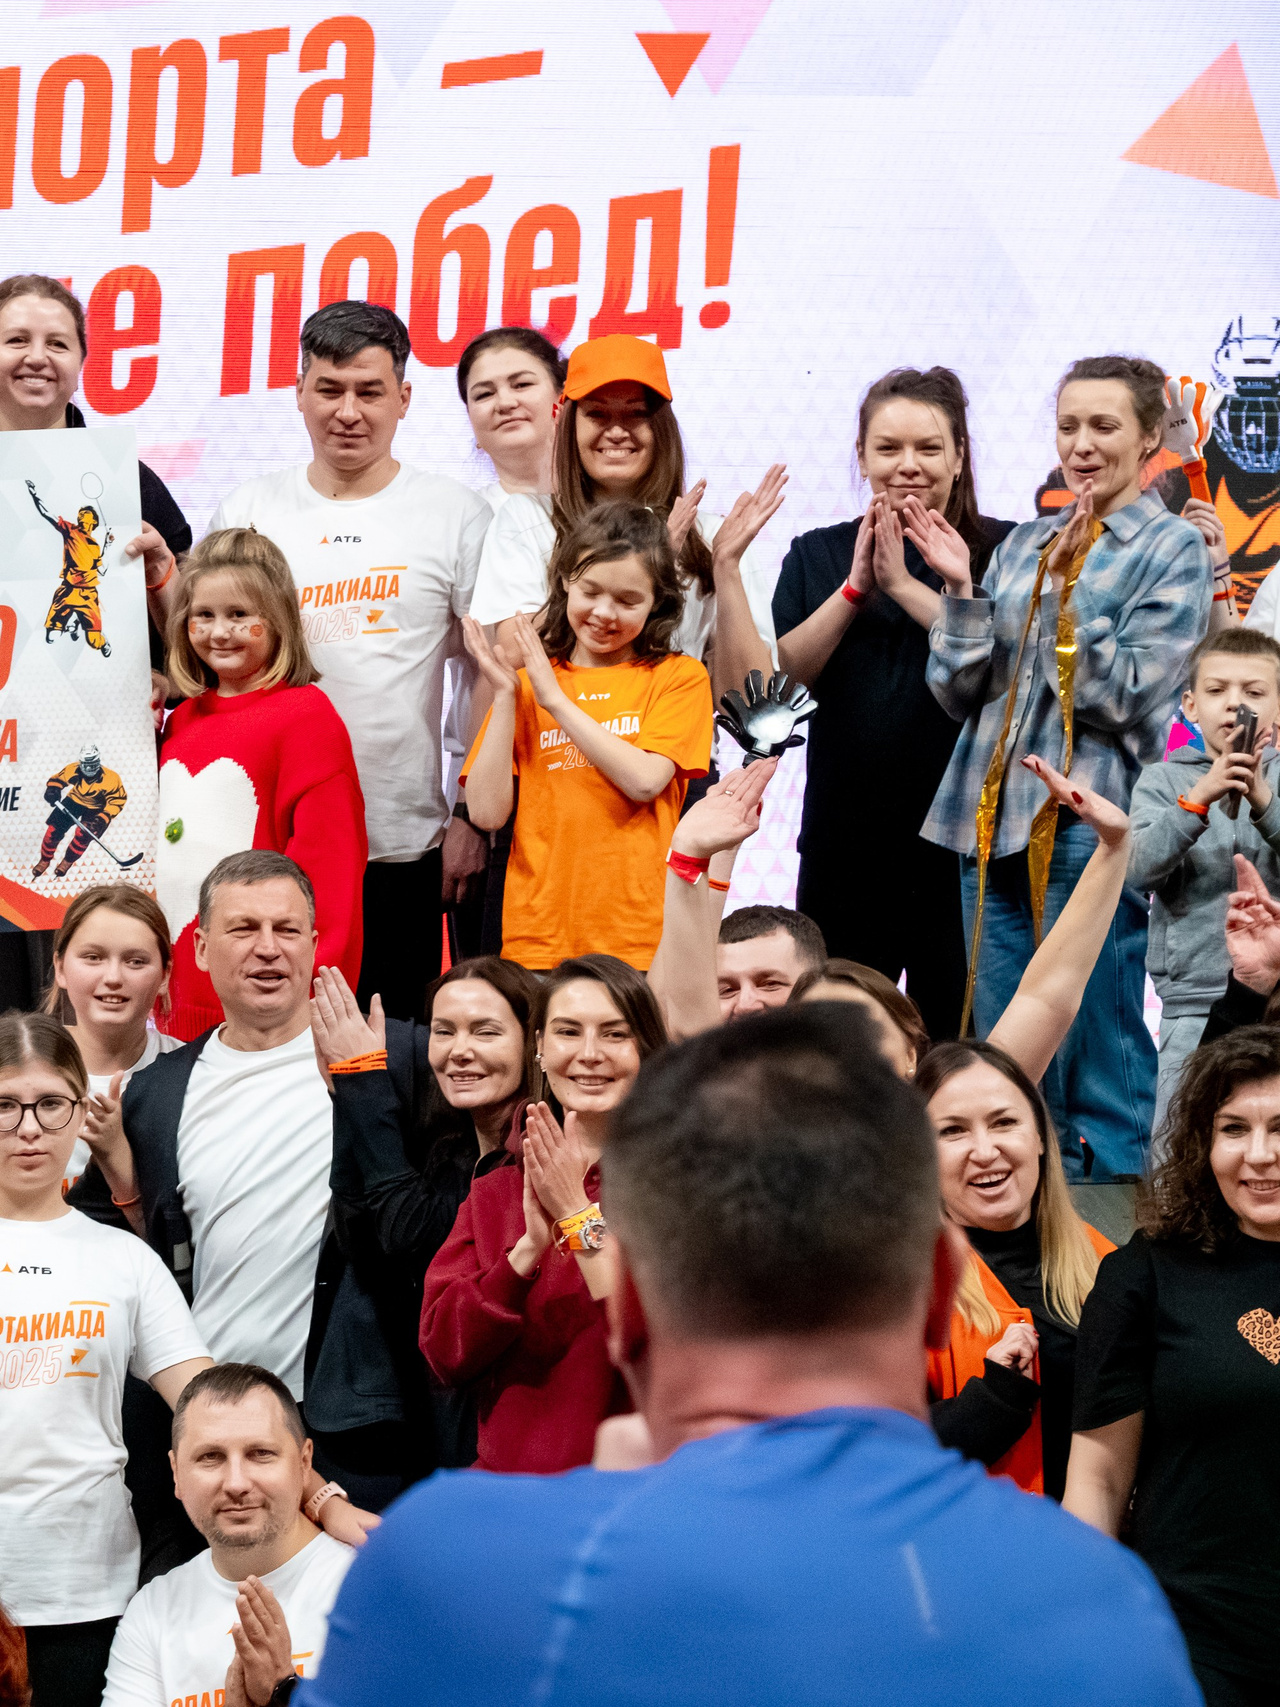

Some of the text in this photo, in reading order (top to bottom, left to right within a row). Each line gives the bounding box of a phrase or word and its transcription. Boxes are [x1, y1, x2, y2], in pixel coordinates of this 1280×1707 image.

[219, 143, 742, 398] побед!
[1169, 418, 1188, 429] АТБ
[333, 535, 362, 543] АТБ
[296, 574, 400, 610] РТАКИАДА
[588, 692, 611, 701] АТБ
[18, 1265, 53, 1275] АТБ
